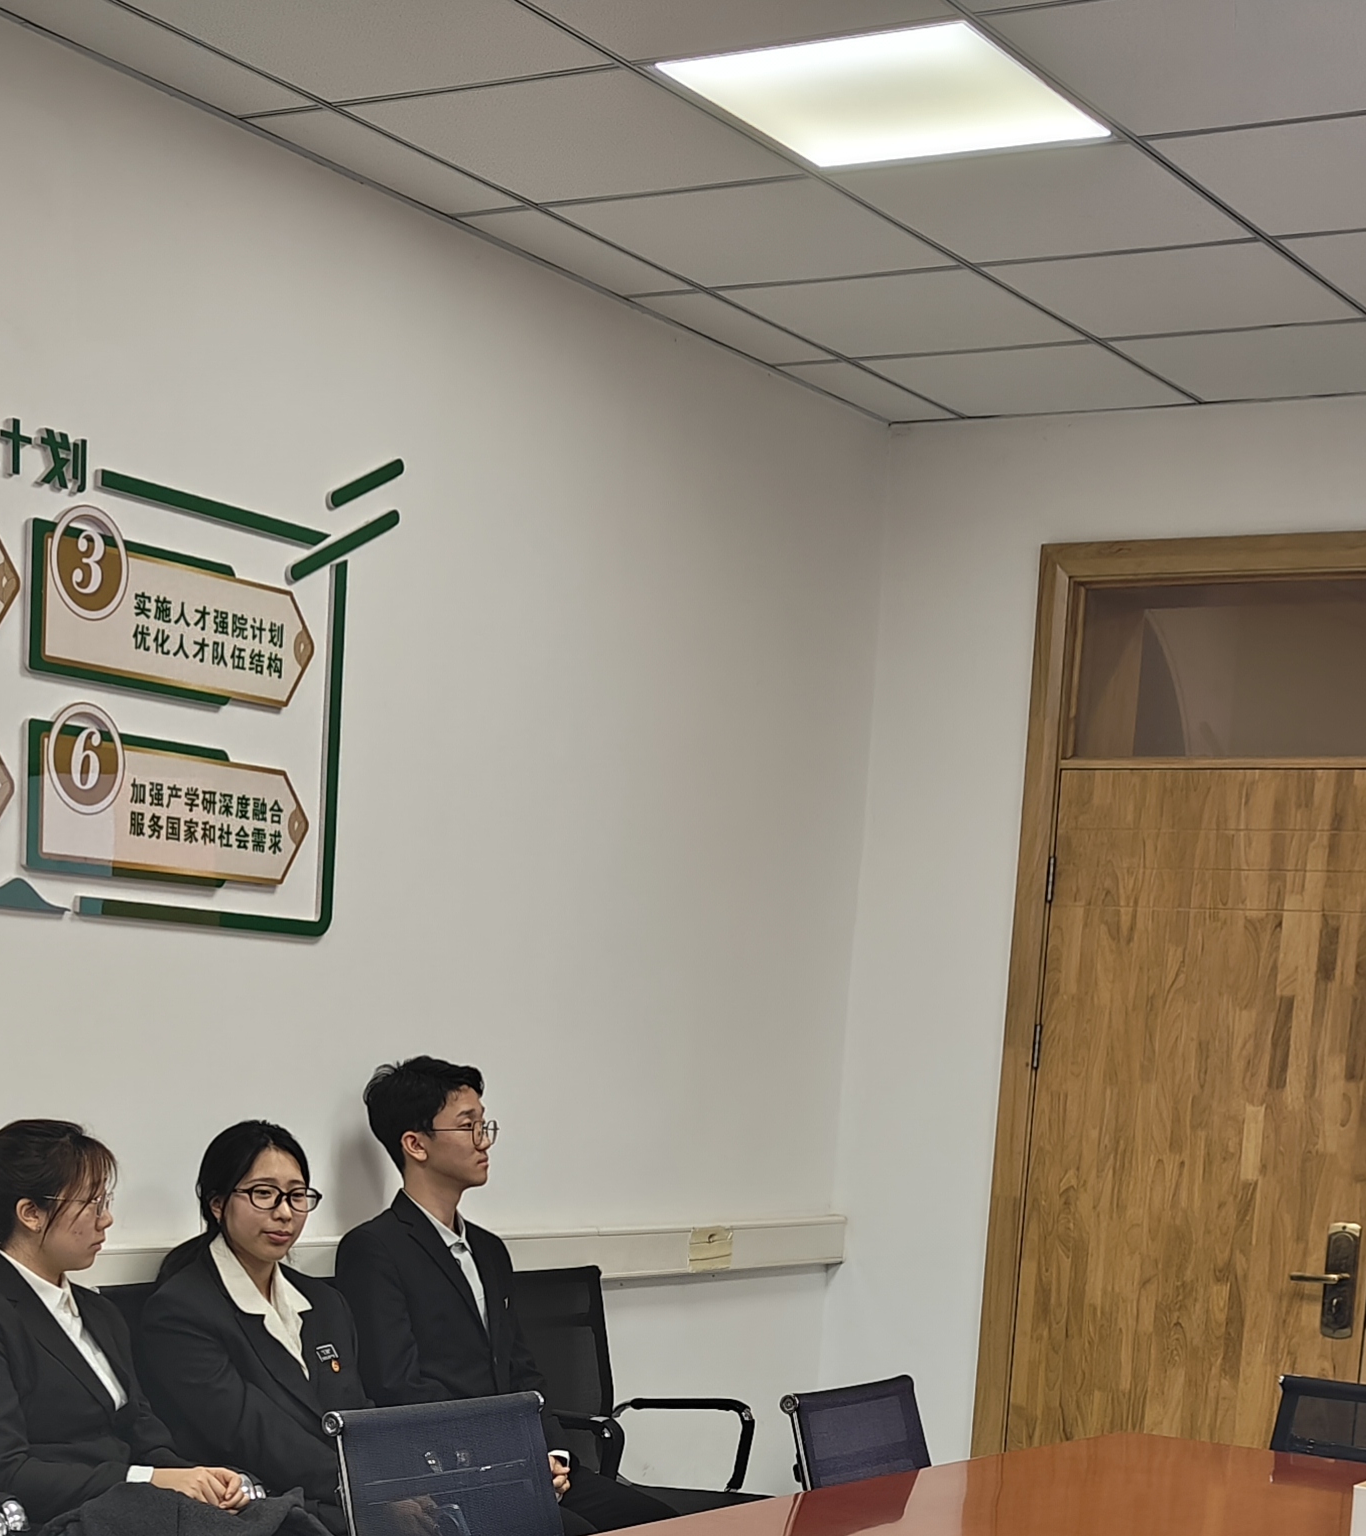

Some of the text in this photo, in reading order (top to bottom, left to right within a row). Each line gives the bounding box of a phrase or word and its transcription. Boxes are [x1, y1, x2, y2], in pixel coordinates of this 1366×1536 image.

[72, 530, 105, 594] 3
[134, 592, 284, 649] 实施人才强院计划
[133, 624, 283, 679] 优化人才队伍结构
[71, 727, 103, 790] 6
[130, 778, 284, 825] 加强产学研深度融合
[129, 812, 283, 855] 服务国家和社会需求
